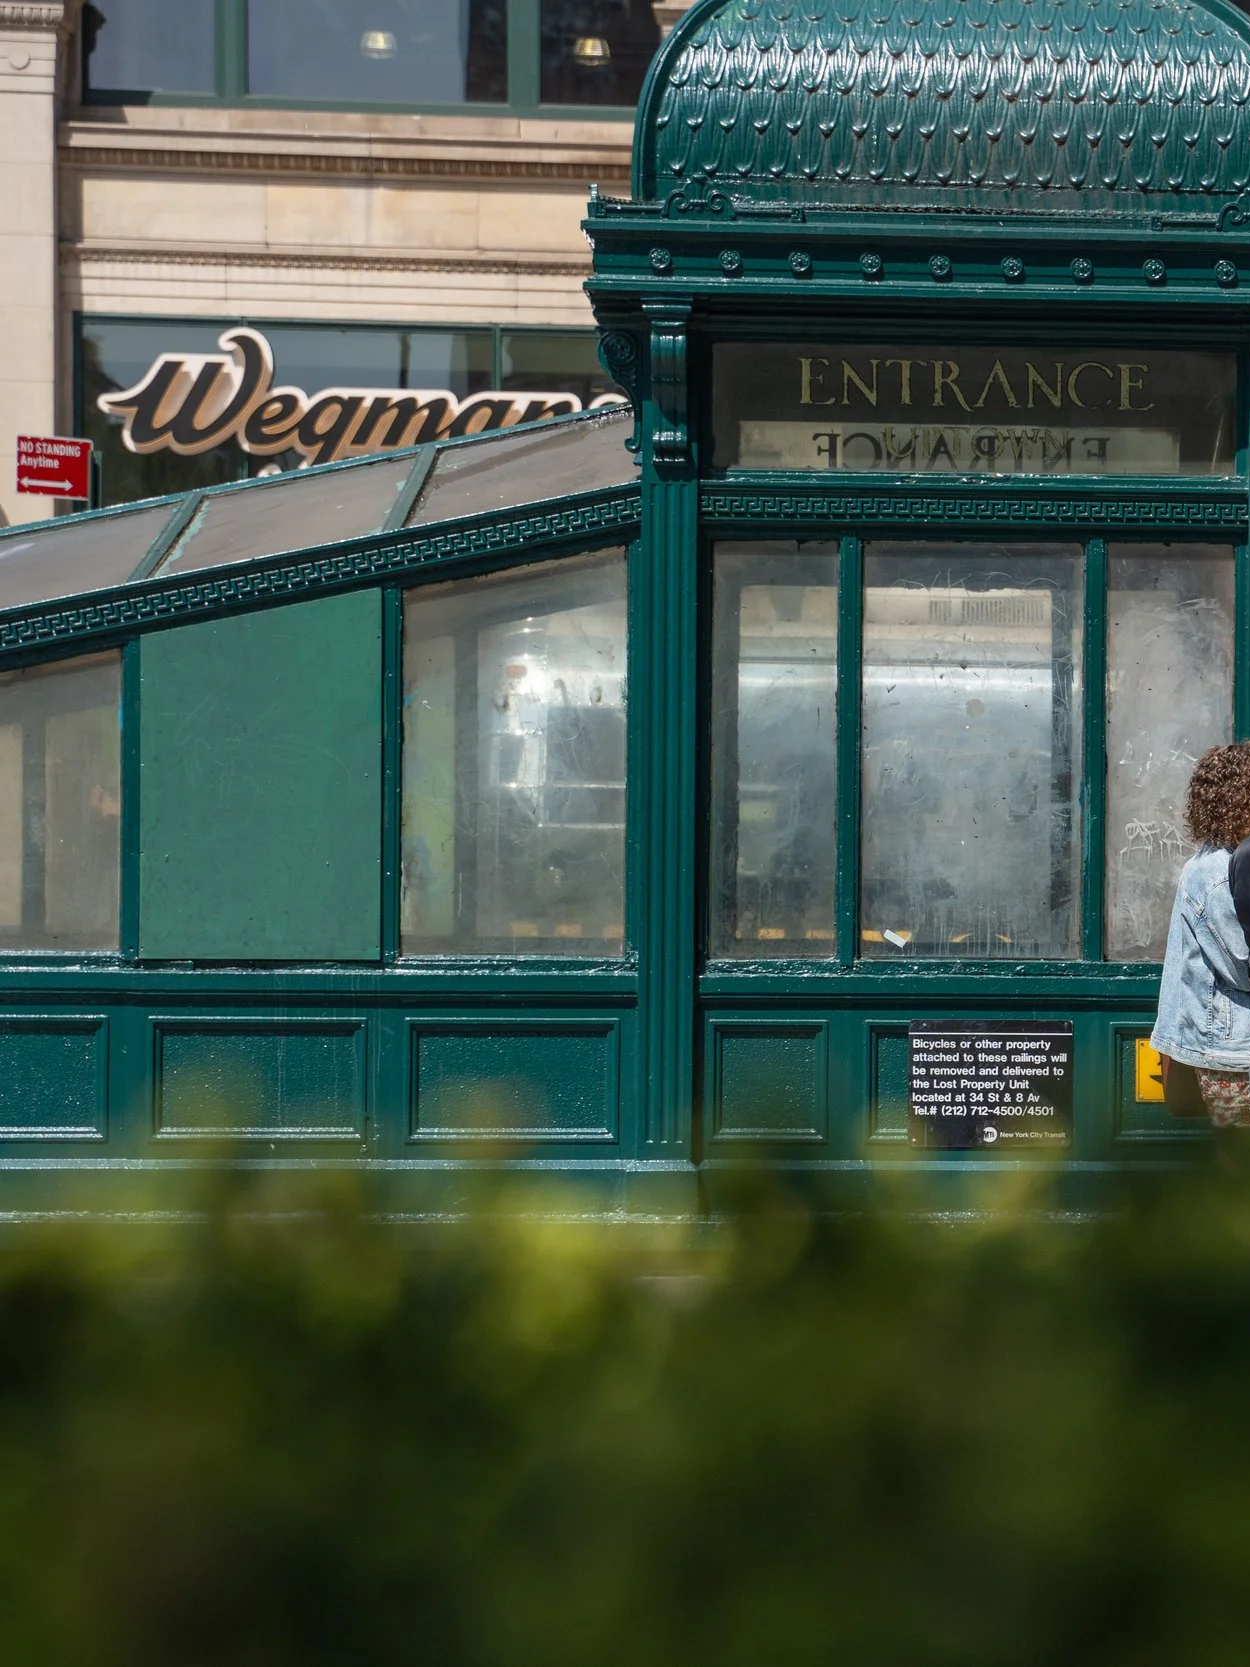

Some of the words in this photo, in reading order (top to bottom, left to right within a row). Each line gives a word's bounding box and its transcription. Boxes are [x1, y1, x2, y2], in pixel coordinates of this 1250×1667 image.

[798, 357, 1154, 412] ENTRANCE
[102, 333, 619, 467] Wegma
[20, 441, 34, 453] NO
[35, 442, 81, 458] STANDING
[882, 426, 1072, 463] UPTOWN
[21, 454, 60, 469] Anytime
[913, 1039, 956, 1050] Bicycles
[975, 1038, 1003, 1049] other
[1006, 1040, 1051, 1050] property
[913, 1053, 959, 1062] attached
[963, 1053, 974, 1062] to
[978, 1053, 1007, 1062] these
[1011, 1053, 1047, 1064] railings
[1051, 1053, 1067, 1062] will
[913, 1066, 926, 1075] be
[930, 1066, 975, 1075] removed
[979, 1066, 998, 1075] and
[1002, 1066, 1049, 1075] delivered
[1053, 1067, 1064, 1076] to
[913, 1079, 929, 1088] the
[934, 1079, 957, 1088] Lost
[961, 1079, 1005, 1090] Property
[1009, 1080, 1029, 1089] Unit
[913, 1092, 951, 1102] located
[955, 1093, 965, 1102] at
[969, 1093, 984, 1102] 34
[988, 1093, 999, 1102] St
[1004, 1093, 1011, 1102] &
[1016, 1093, 1023, 1102] 8
[1027, 1093, 1040, 1102] Av
[913, 1106, 937, 1115] Tel.#
[942, 1105, 967, 1116] (212)
[970, 1106, 1053, 1116] 712-4500/4501
[1029, 1131, 1043, 1140] City
[1043, 1131, 1066, 1139] Transit
